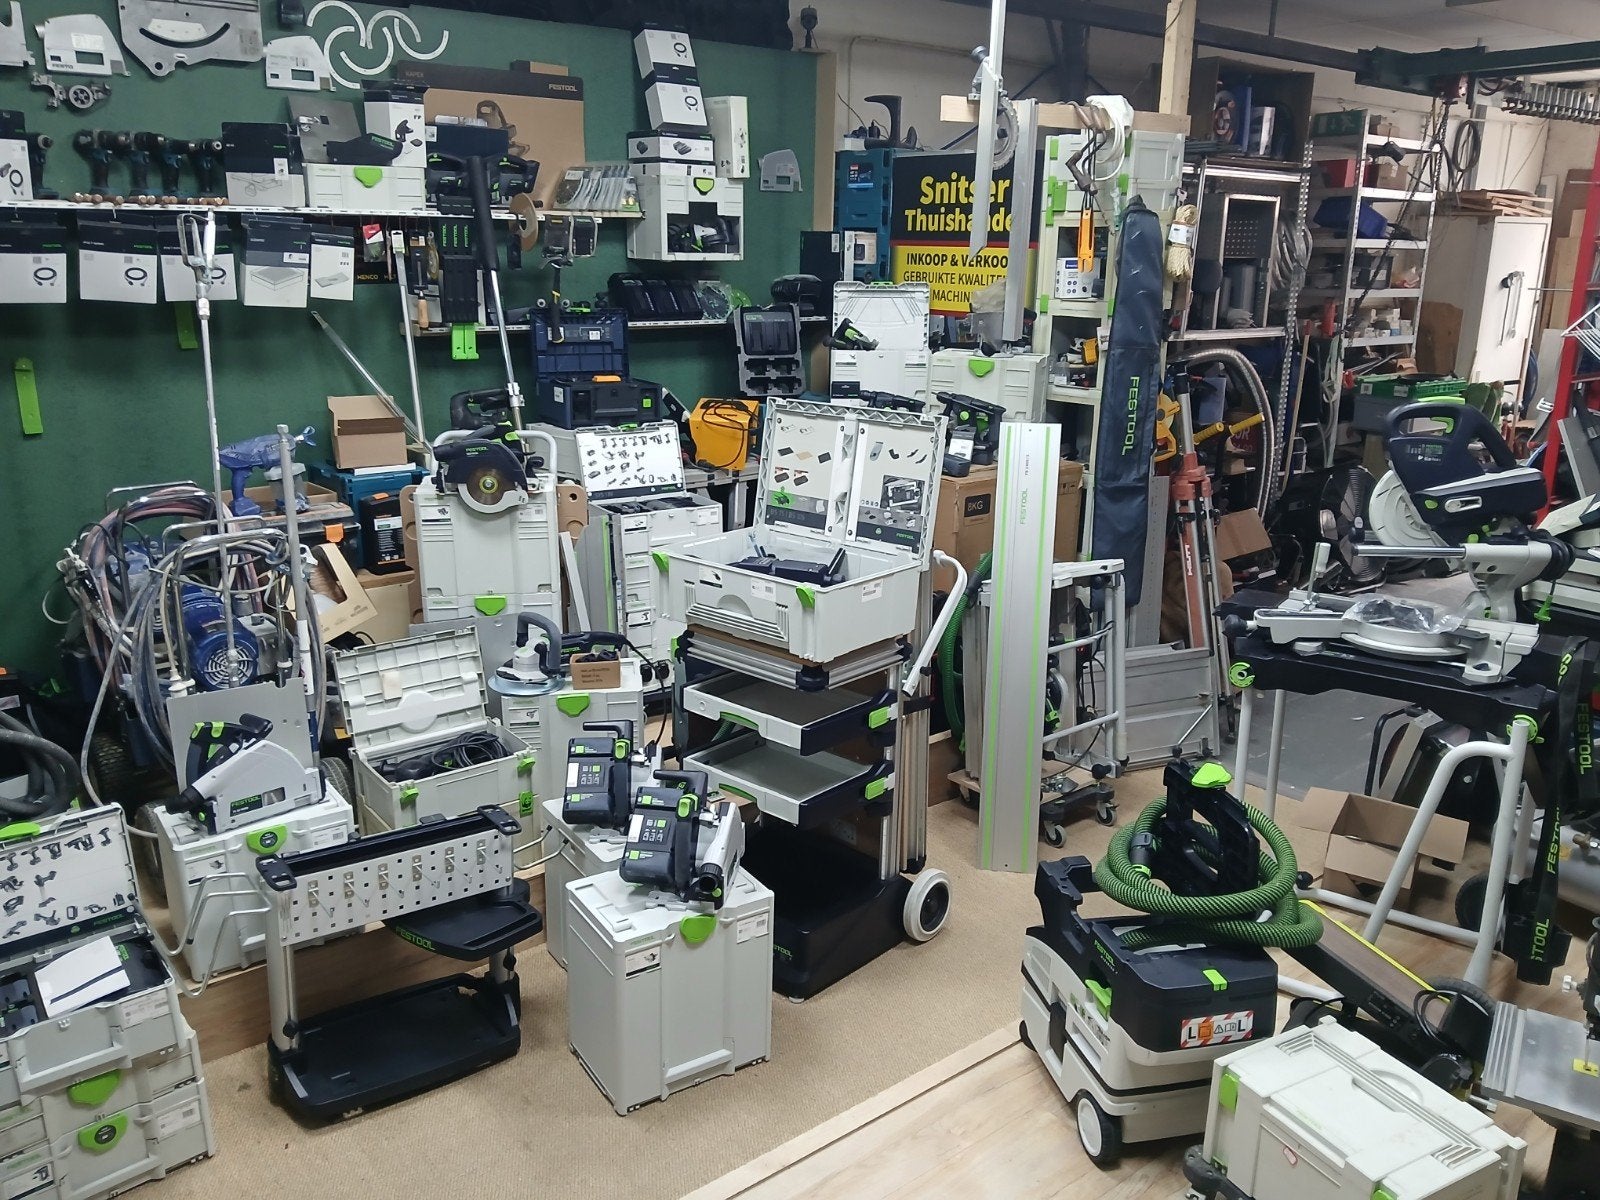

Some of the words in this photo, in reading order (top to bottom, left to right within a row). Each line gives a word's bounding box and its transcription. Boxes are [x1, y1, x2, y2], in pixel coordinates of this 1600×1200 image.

[907, 253, 948, 267] INKOOP
[950, 254, 959, 267] &
[961, 255, 1009, 269] VERKOO
[903, 270, 955, 284] GEBRUIKTE
[932, 290, 971, 303] MACHIN
[1121, 376, 1140, 455] FESTOOL
[967, 500, 983, 512] 8KG
[1020, 488, 1028, 525] FESTOOL
[1577, 703, 1592, 775] FESTOOL
[396, 926, 436, 951] FESTOOL
[1188, 1027, 1197, 1039] L
[1237, 1020, 1246, 1032] L
